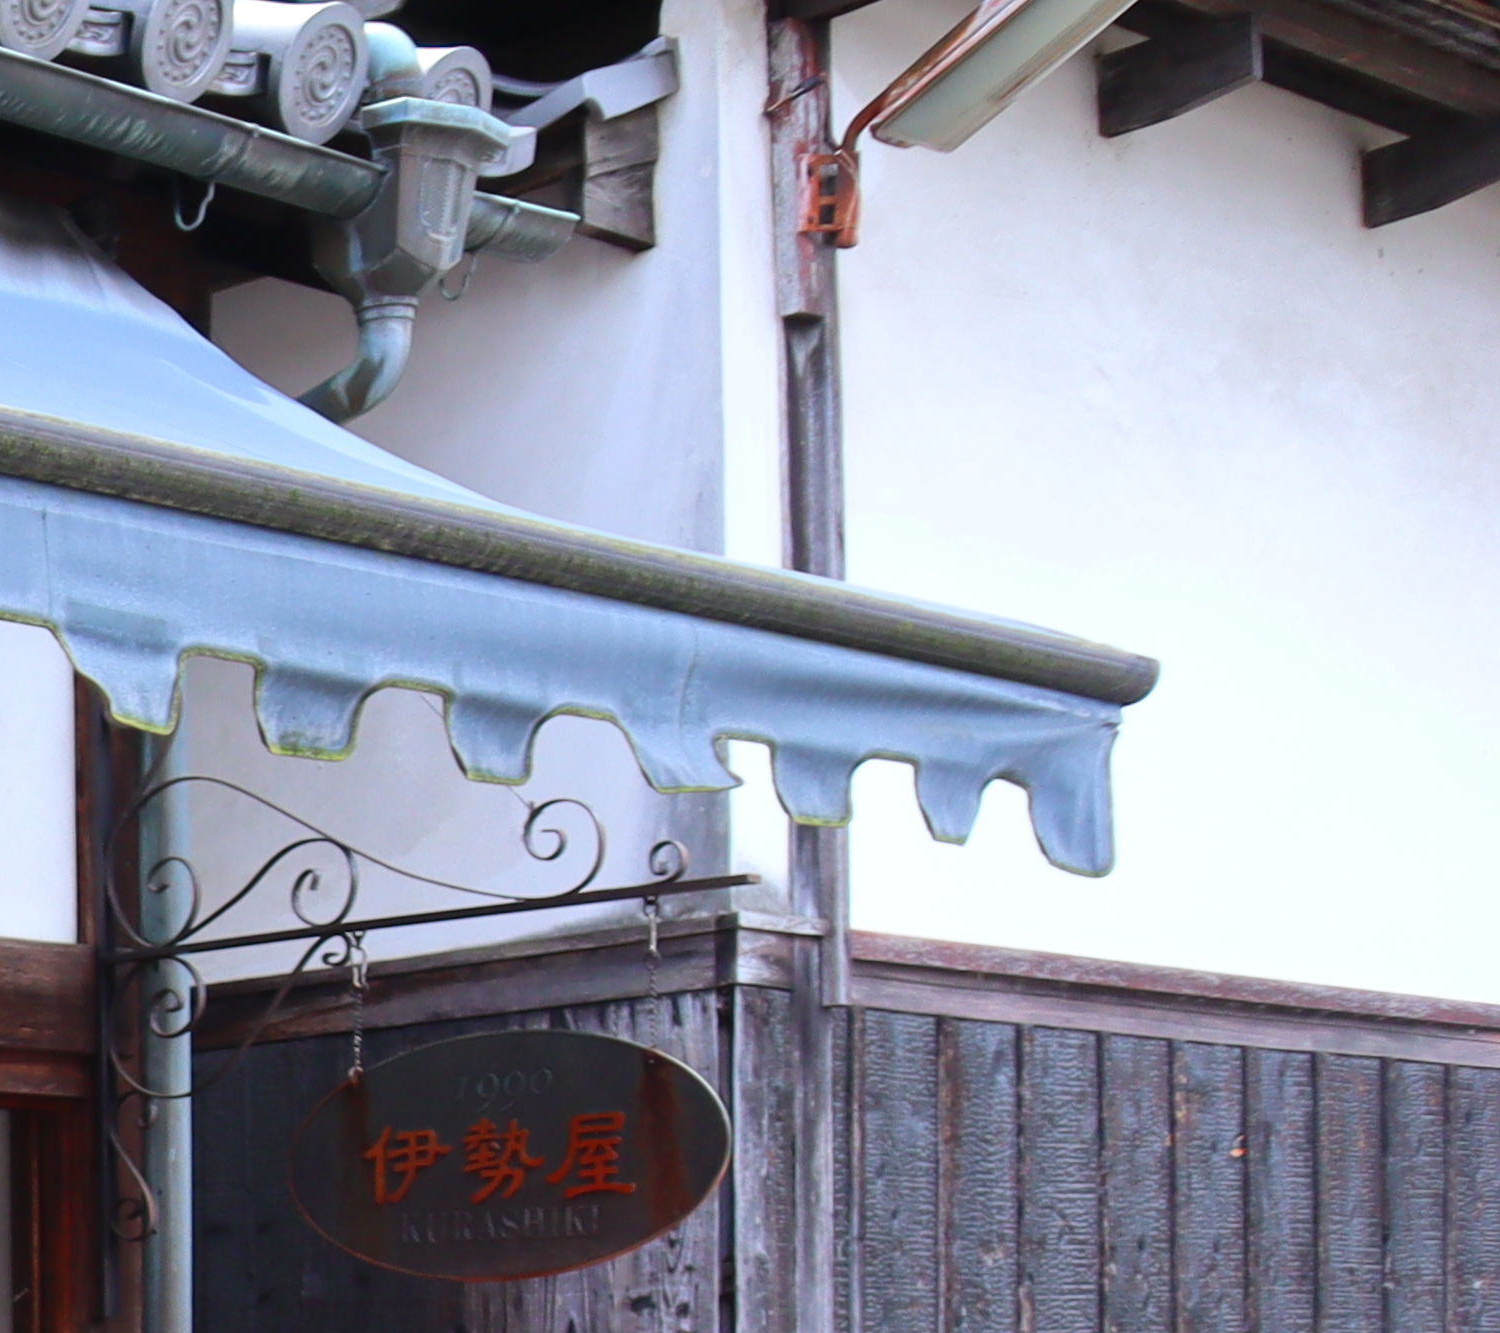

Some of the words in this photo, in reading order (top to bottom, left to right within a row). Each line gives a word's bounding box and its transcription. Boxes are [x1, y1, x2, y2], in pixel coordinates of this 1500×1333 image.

[363, 1111, 637, 1204] 伊勢屋
[400, 1205, 602, 1246] KURASHIKI
